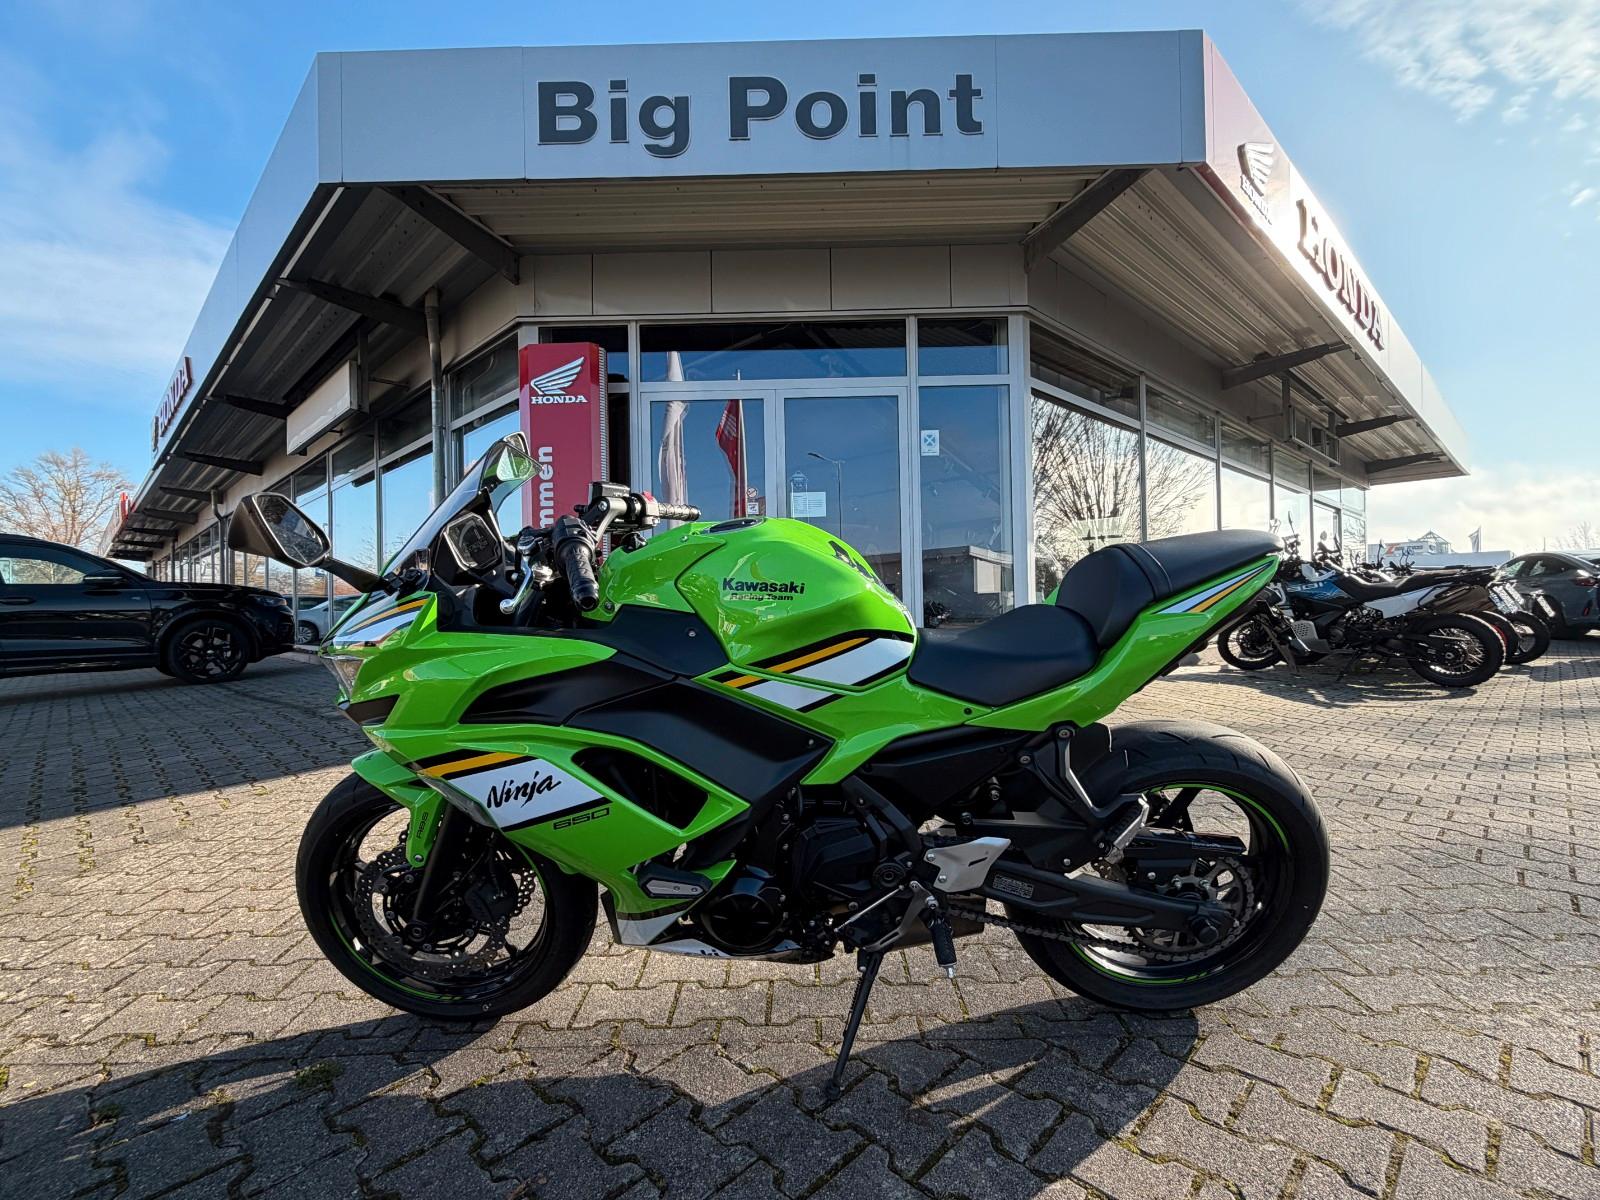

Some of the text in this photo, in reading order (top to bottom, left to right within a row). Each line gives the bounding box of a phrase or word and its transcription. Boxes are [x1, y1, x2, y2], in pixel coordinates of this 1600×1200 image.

[537, 73, 985, 159] Big Point
[1296, 199, 1385, 351] HONDA
[530, 394, 589, 405] HONDA
[722, 577, 806, 594] Kawasaki
[730, 592, 794, 602] Racing Team
[486, 770, 562, 809] Ninja
[553, 807, 610, 830] 650
